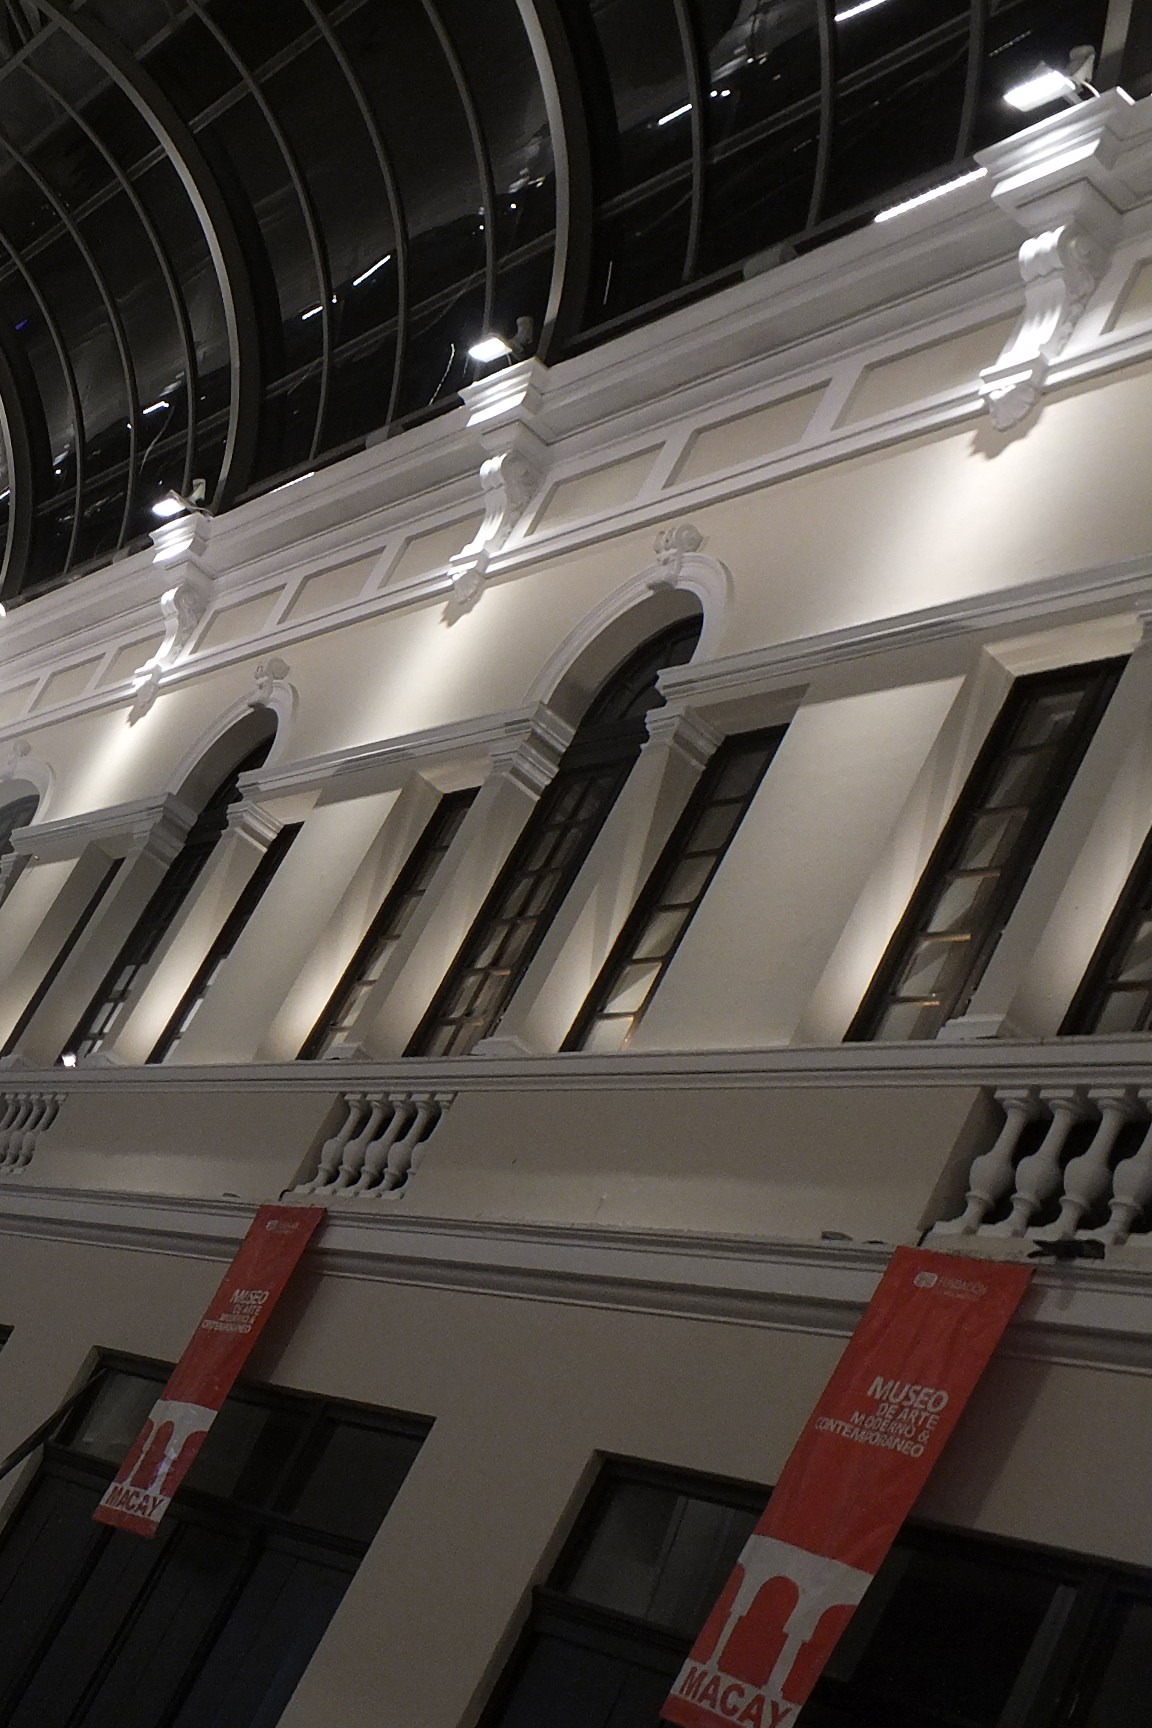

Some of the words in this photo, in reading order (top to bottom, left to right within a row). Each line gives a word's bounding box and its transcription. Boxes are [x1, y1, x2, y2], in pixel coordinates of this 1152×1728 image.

[229, 1289, 270, 1305] MUSEO
[866, 1375, 949, 1414] MUSEO
[850, 1410, 916, 1439] MODERNO
[918, 1429, 931, 1445] &
[876, 1402, 899, 1420] DE
[896, 1407, 941, 1431] ARTE
[105, 1485, 165, 1517] MACAY
[678, 1666, 793, 1728] MACAY
